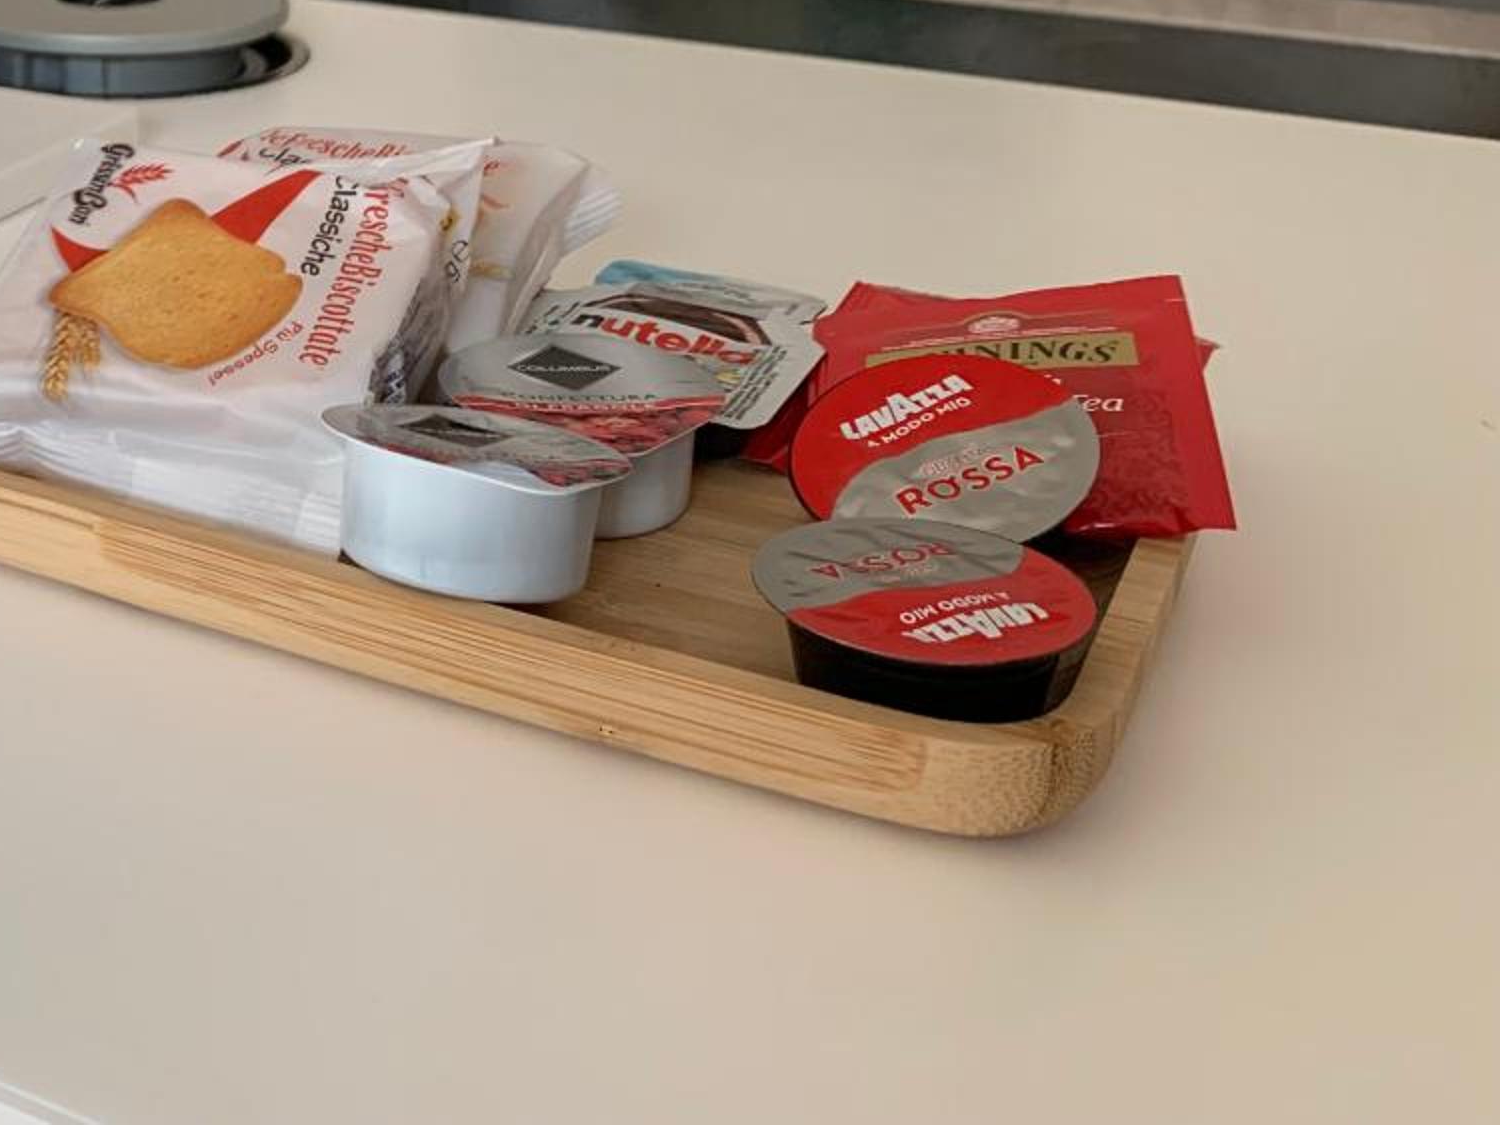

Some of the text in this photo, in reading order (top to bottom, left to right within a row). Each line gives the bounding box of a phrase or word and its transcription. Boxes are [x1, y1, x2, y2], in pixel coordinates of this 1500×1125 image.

[569, 312, 756, 366] nutella
[839, 374, 974, 440] LAVAZZA
[881, 412, 935, 445] MODO
[937, 396, 972, 416] MIO
[896, 446, 1045, 516] ROSSA
[899, 604, 938, 625] MIO
[901, 602, 1049, 644] LAVAZZA
[937, 592, 996, 613] MODO
